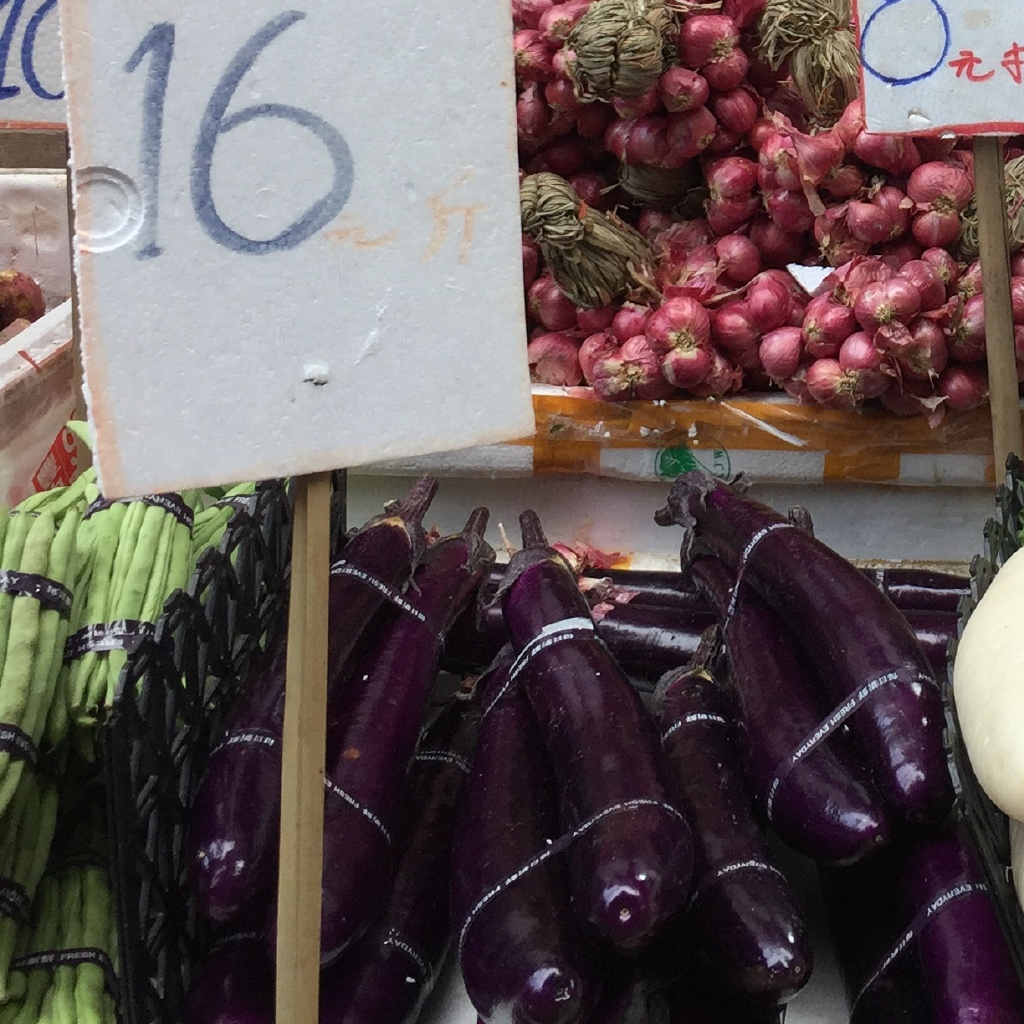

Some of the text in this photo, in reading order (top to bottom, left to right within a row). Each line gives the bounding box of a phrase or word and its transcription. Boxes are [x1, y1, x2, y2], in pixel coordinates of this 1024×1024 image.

[125, 9, 354, 261] 16
[830, 700, 856, 727] FRESH
[792, 723, 830, 764] EVERYDAY
[926, 883, 973, 917] EVERYDAY
